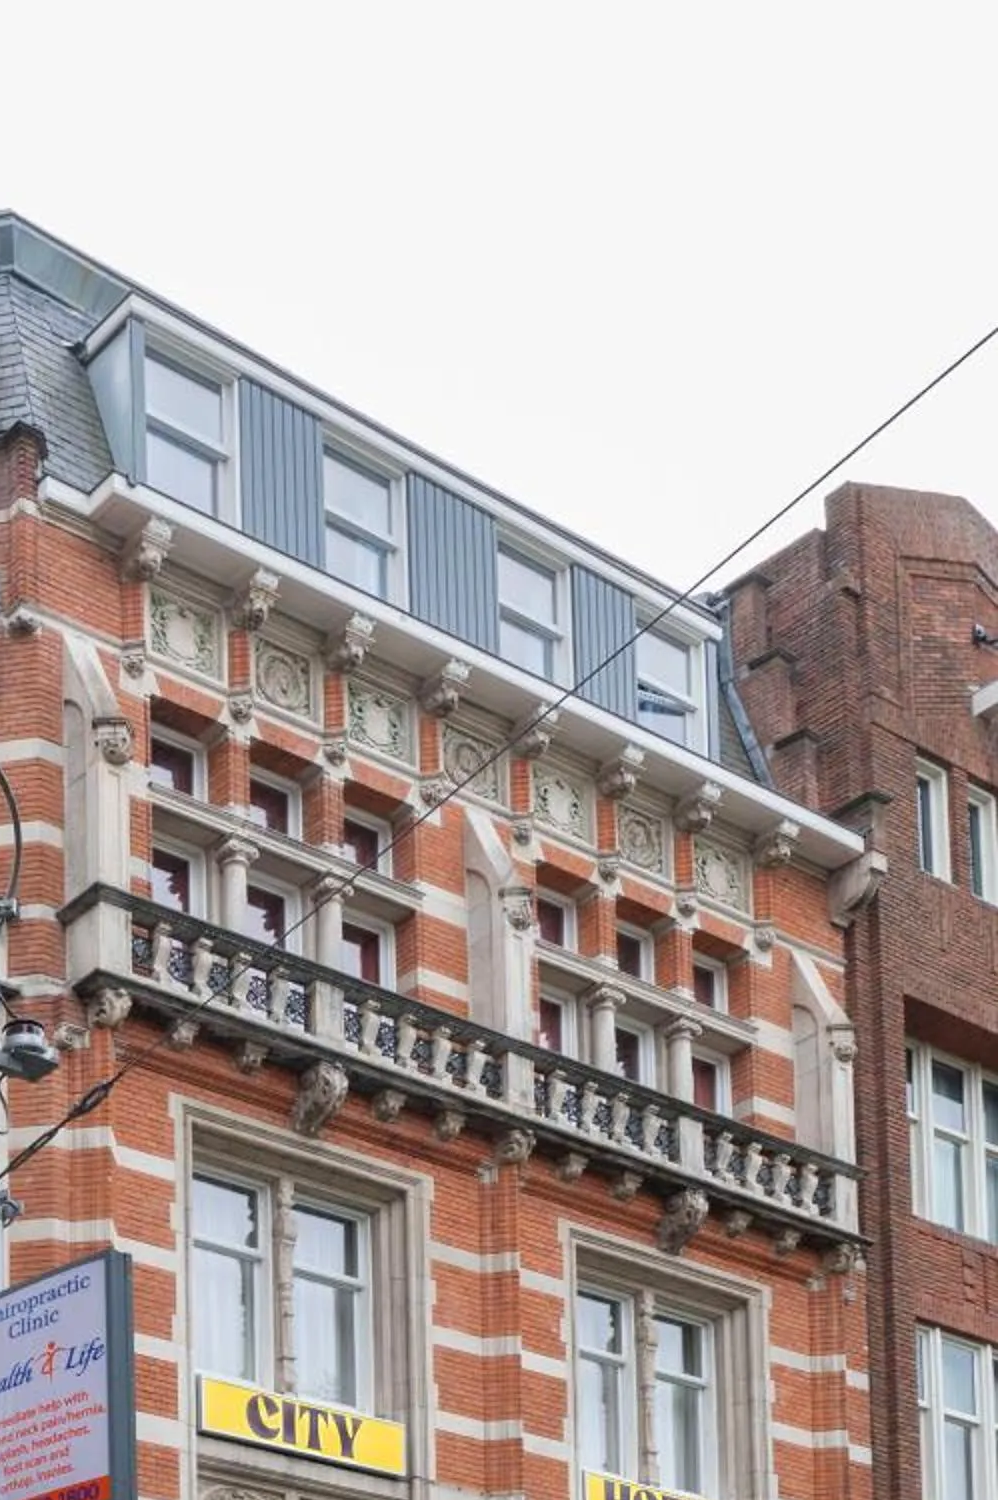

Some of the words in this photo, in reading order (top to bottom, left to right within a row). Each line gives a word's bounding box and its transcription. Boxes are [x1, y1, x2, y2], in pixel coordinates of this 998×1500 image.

[8, 1308, 59, 1339] Clinic
[65, 1337, 105, 1376] Life
[64, 1391, 90, 1407] with
[246, 1392, 363, 1459] CITY
